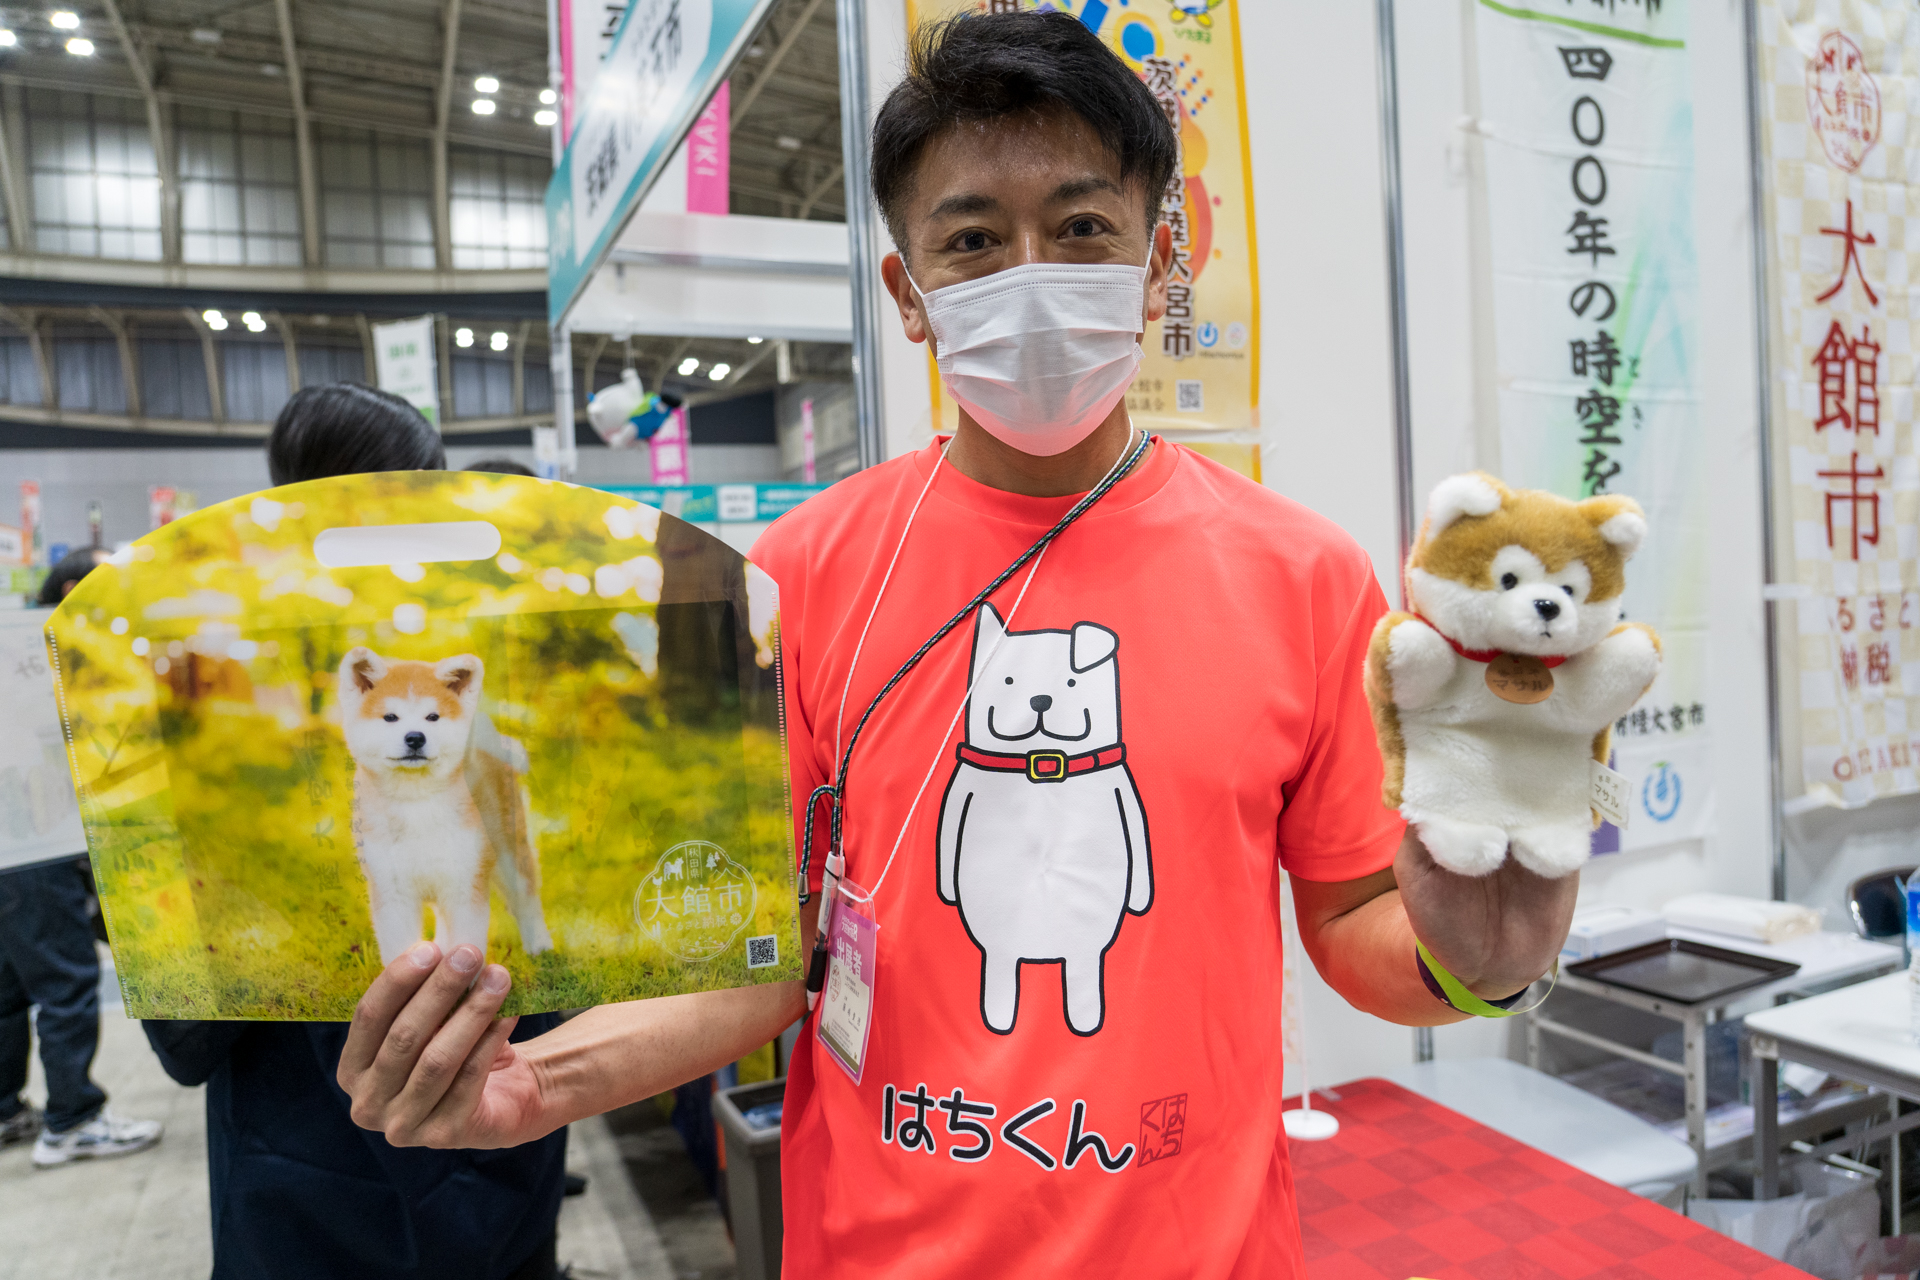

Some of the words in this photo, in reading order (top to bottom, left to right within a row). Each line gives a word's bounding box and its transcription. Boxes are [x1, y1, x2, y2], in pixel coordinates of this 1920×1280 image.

[1813, 200, 1884, 560] 大館市
[1829, 593, 1912, 632] るさと
[1493, 679, 1549, 692] マサル
[1595, 783, 1619, 808] マサル
[688, 848, 700, 879] 秋田県
[645, 881, 743, 921] 大館市
[664, 915, 728, 933] ふるさと納税
[882, 1082, 1136, 1174] はちくん
